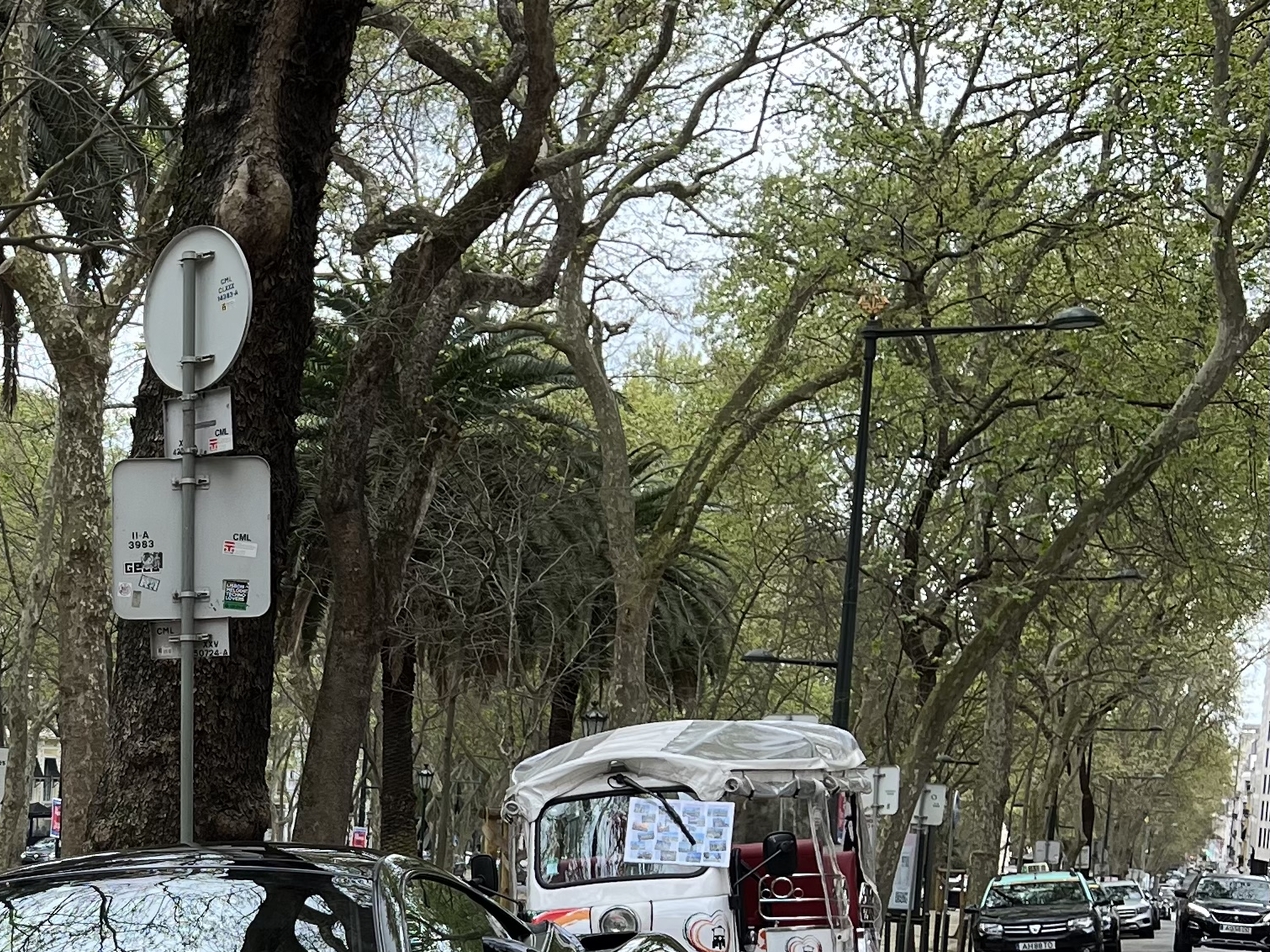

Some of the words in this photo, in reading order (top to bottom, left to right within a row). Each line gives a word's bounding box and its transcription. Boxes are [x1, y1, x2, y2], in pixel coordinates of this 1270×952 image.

[215, 428, 229, 437] CML
[132, 531, 149, 539] II-A
[232, 533, 251, 541] CML
[128, 540, 154, 549] 3983
[157, 627, 174, 635] CML
